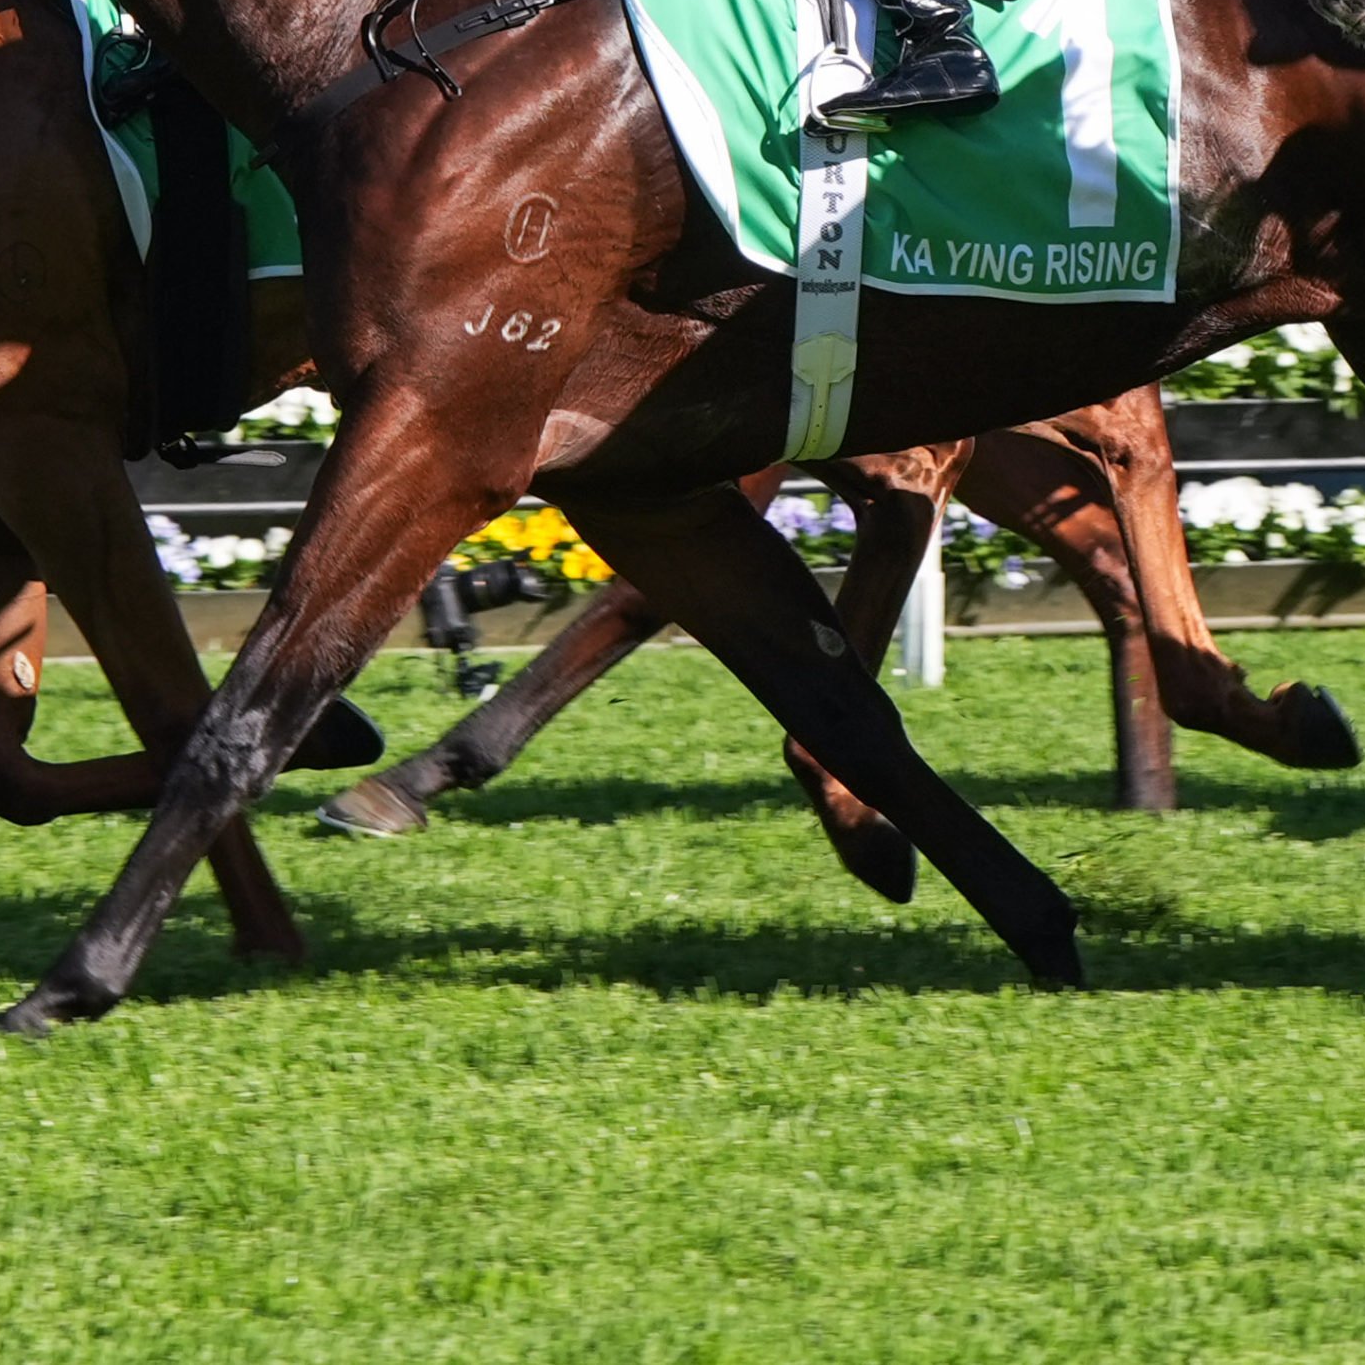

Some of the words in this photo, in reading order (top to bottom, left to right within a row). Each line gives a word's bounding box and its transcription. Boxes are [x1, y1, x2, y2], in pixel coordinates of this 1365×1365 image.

[890, 231, 935, 276] KA
[945, 239, 1034, 286] YING
[1045, 241, 1158, 286] RISING
